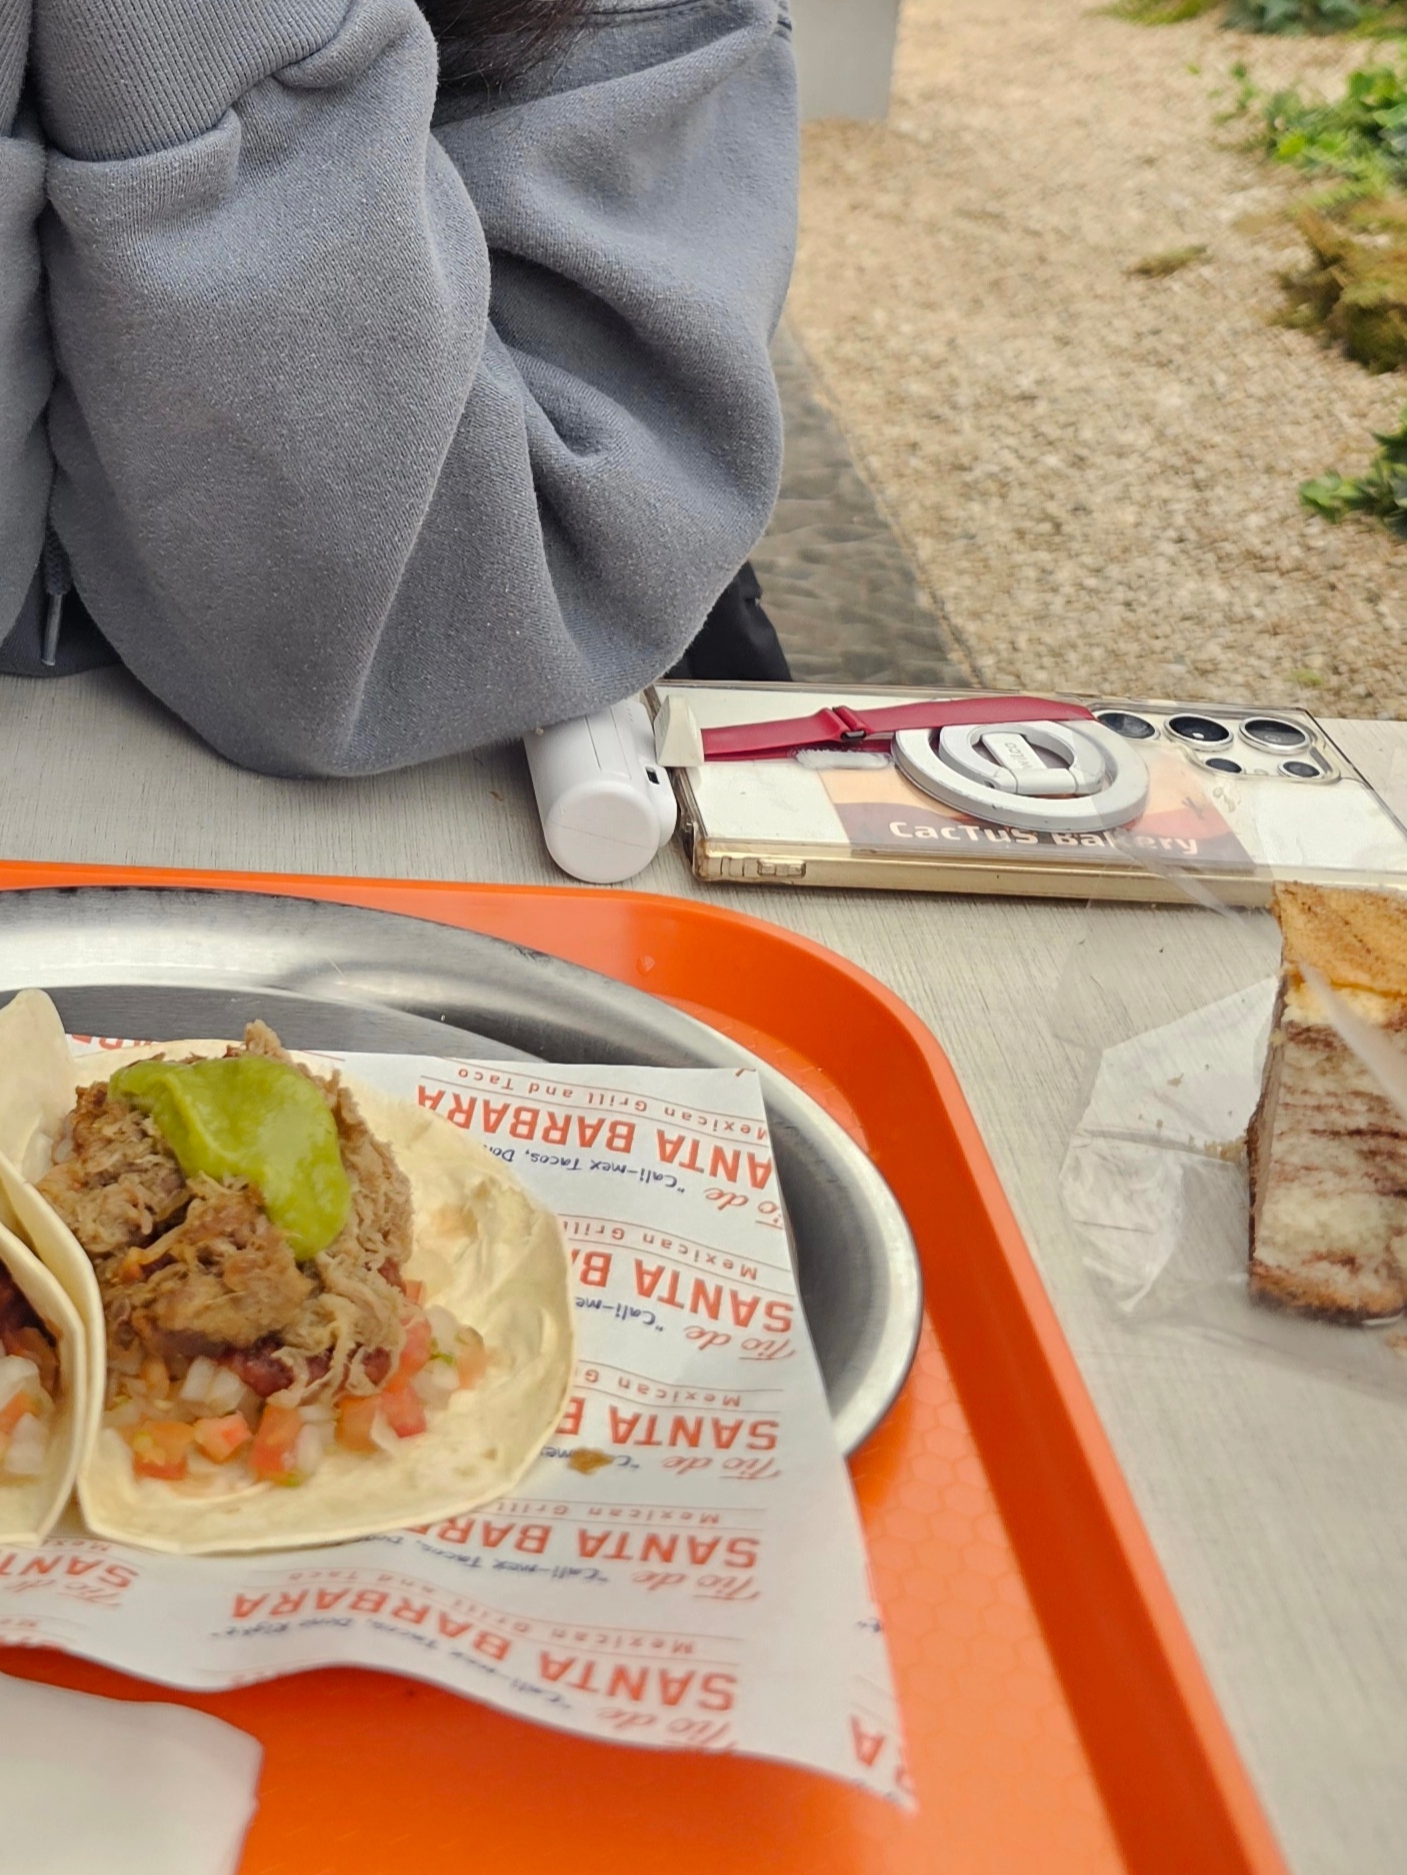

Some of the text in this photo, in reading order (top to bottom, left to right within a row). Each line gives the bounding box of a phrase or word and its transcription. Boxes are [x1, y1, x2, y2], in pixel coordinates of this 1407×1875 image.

[457, 1068, 768, 1140] Mexican Grill and Taco
[416, 1084, 772, 1190] ANTA BARBARA
[525, 1149, 582, 1171] Tacos,
[703, 1187, 749, 1211] de
[643, 1234, 758, 1280] Mexican
[635, 1258, 793, 1333] SANTA
[575, 1296, 663, 1332] "Cali-me
[683, 1325, 732, 1351] de
[618, 1376, 741, 1408] Mexican
[608, 1405, 780, 1451] SANTA
[660, 1455, 713, 1475] de
[587, 1507, 721, 1525] Mexican
[577, 1528, 761, 1568] SANTA
[231, 1588, 739, 1712] SANTA BARBARA
[549, 1626, 694, 1654] Mexican
